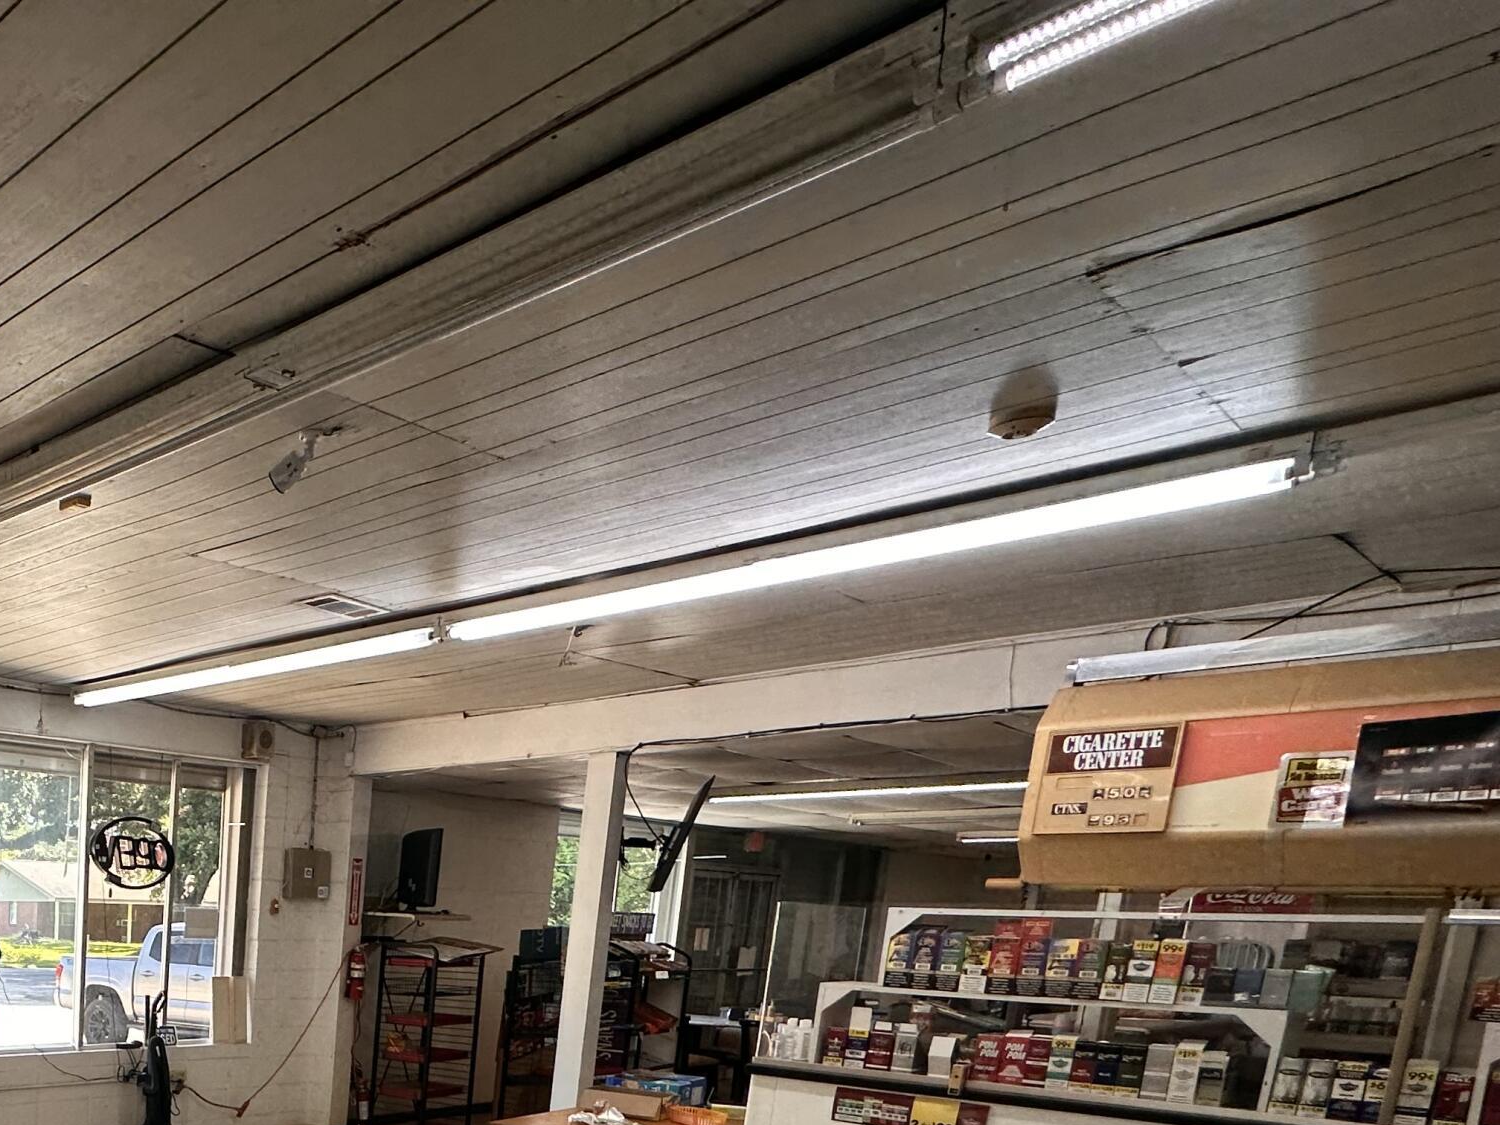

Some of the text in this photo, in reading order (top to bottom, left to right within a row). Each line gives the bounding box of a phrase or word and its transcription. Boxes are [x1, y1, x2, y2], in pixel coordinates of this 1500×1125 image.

[1063, 729, 1165, 754] CIGARETTE
[1074, 750, 1144, 770] CENTER
[979, 1041, 998, 1050] POM
[1005, 1043, 1025, 1052] POM
[980, 1049, 999, 1058] POM
[1006, 1051, 1027, 1060] POM
